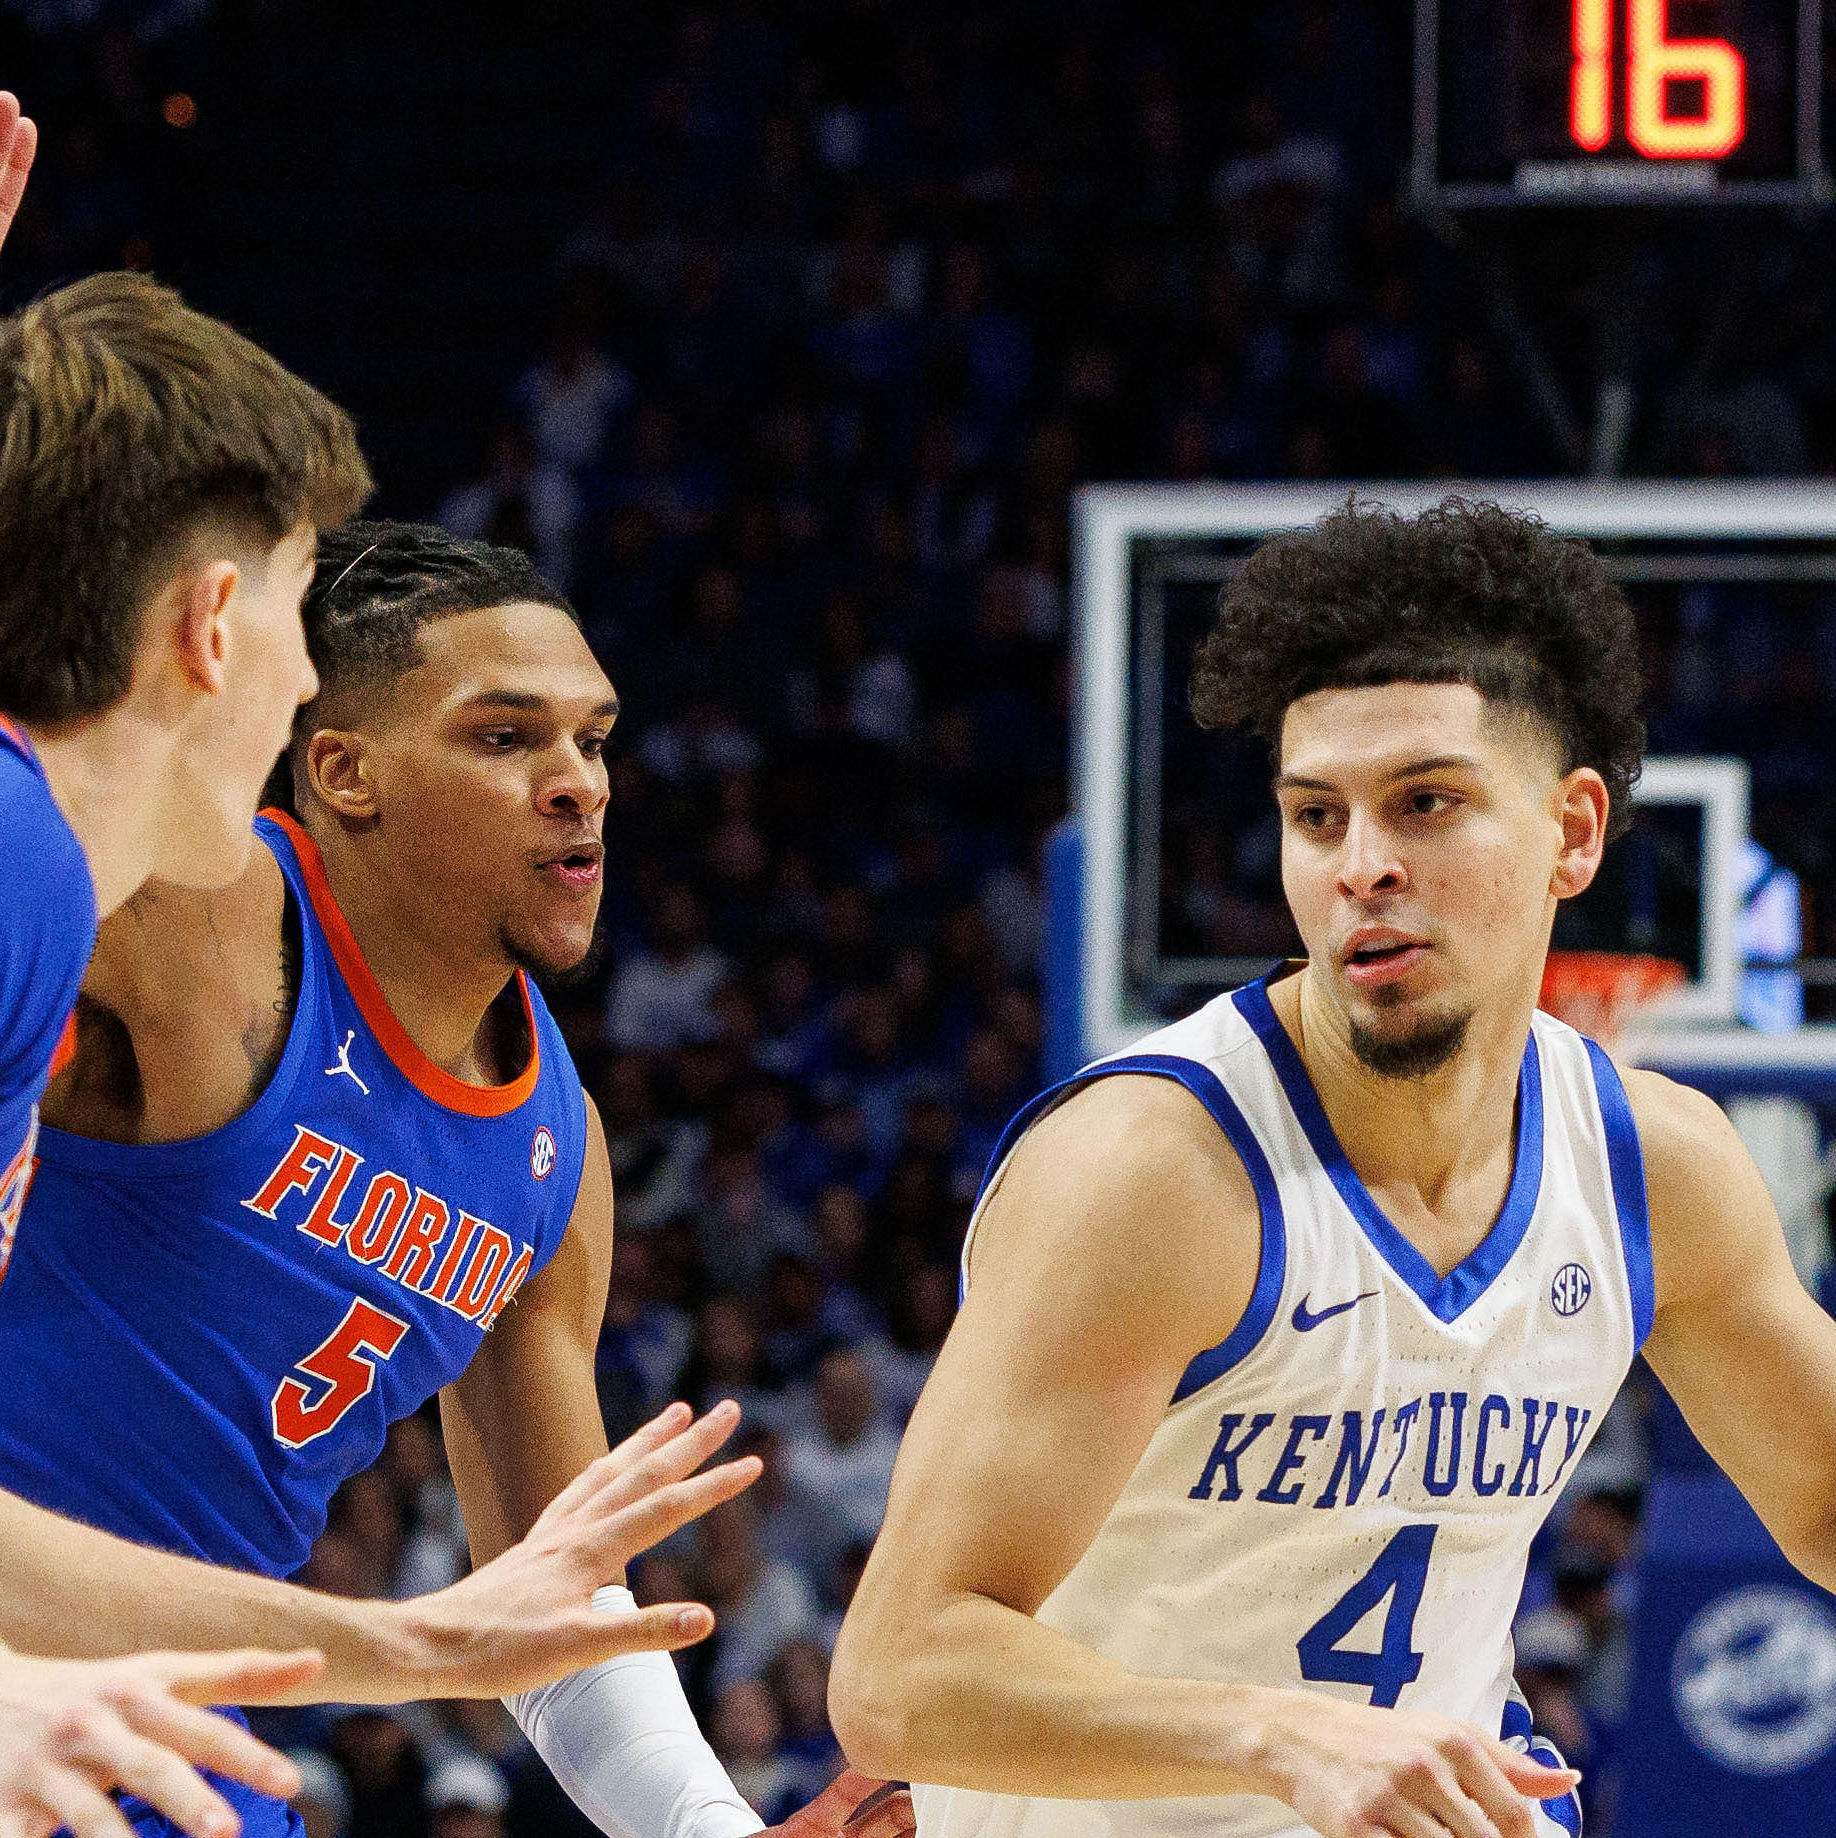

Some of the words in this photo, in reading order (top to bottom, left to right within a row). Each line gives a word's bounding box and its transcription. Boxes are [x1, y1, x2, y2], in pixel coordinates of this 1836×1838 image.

[1571, 0, 1745, 158] 16
[1552, 1264, 1590, 1315] SEC
[271, 1296, 410, 1448] 5
[1188, 1392, 1591, 1508] KENTUCKY
[1296, 1524, 1438, 1709] 4
